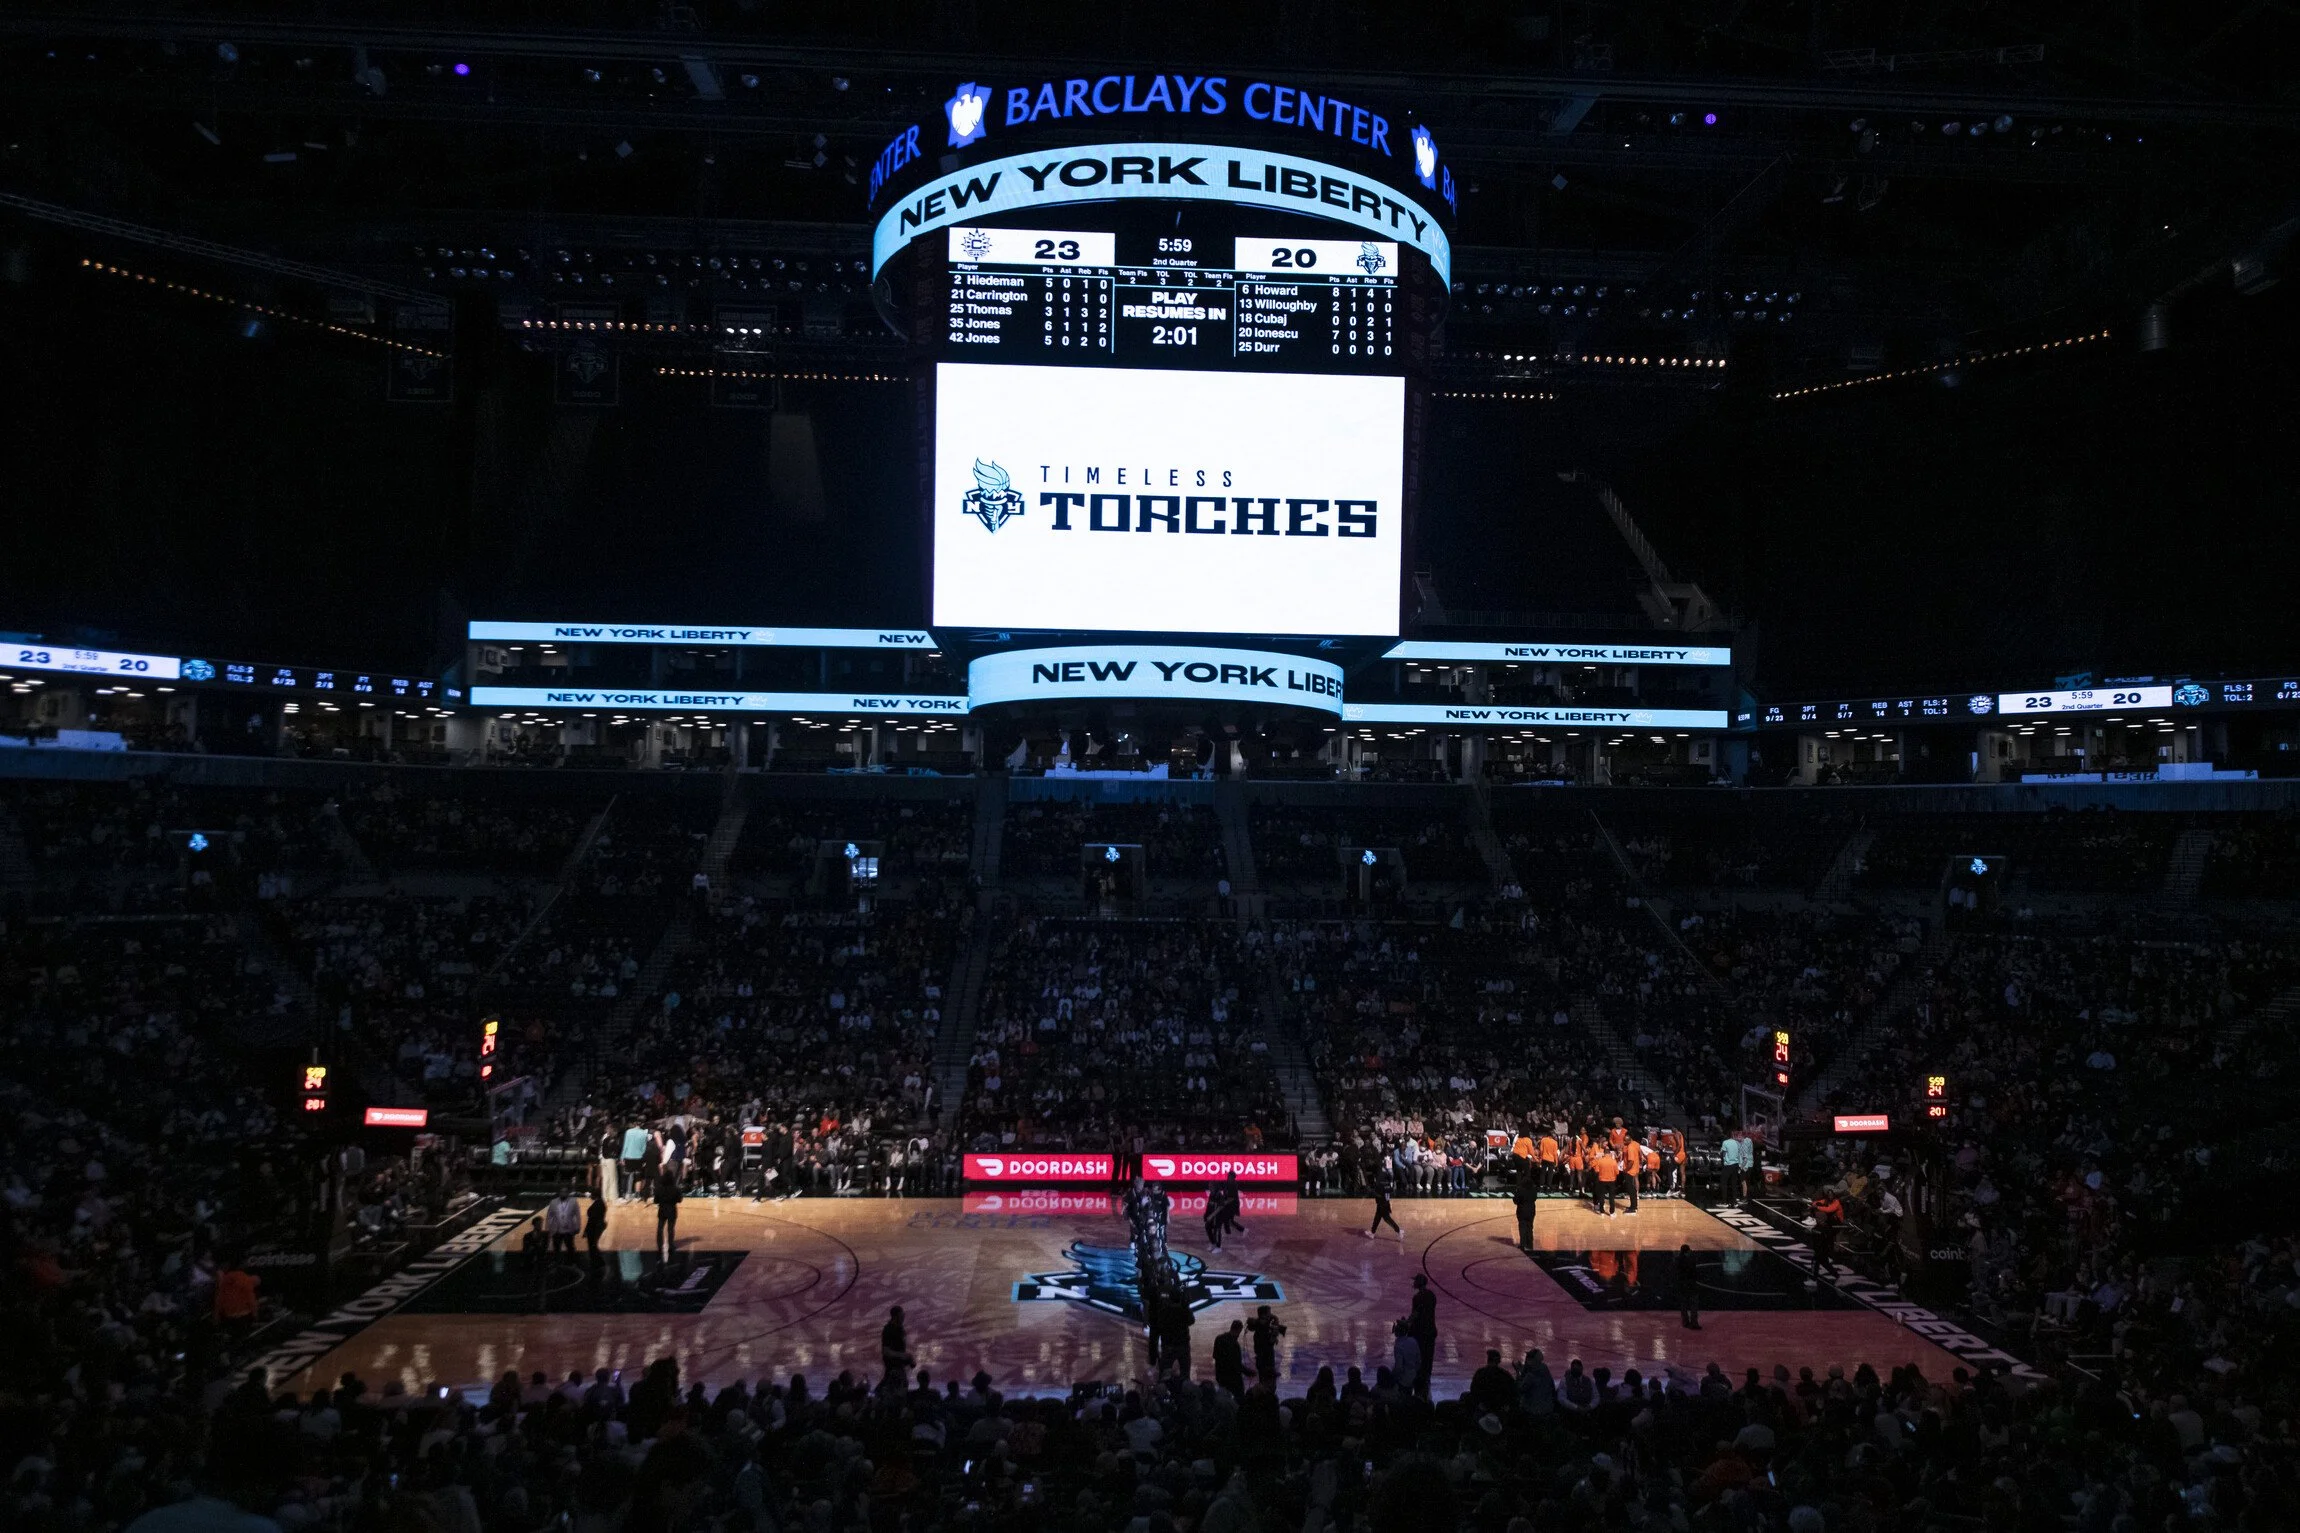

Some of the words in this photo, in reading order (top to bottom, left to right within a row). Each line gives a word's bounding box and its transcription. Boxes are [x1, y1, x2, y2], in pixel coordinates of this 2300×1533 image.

[1005, 75, 1227, 127] BARCLAYS
[1244, 81, 1392, 157] CENTER
[900, 171, 1002, 237] NEW
[1017, 156, 1210, 192] YORK
[1228, 160, 1427, 243] LIBERTY
[1035, 240, 1080, 260] 23
[1159, 238, 1192, 252] 5:59
[1272, 248, 1317, 268] 20
[954, 275, 961, 285] 2
[967, 275, 1024, 286] Hiedeman
[1046, 278, 1053, 287] 5
[1063, 279, 1070, 288] 0
[1083, 279, 1088, 288] 1
[1100, 280, 1107, 289] 0
[951, 290, 964, 299] 21
[966, 290, 1027, 302] Carrington
[1045, 292, 1053, 302] 0
[1063, 293, 1070, 302] 0
[1082, 294, 1088, 303] 1
[1100, 294, 1107, 304] 0
[1152, 291, 1197, 305] PLAY
[1242, 285, 1249, 294] 6
[1255, 285, 1298, 296] Howard
[1332, 288, 1339, 297] 8
[1351, 288, 1356, 297] 1
[1367, 289, 1374, 298] 4
[1386, 289, 1391, 298] 1
[950, 304, 964, 313] 25
[966, 304, 1012, 315] Thomas
[1045, 307, 1052, 316] 3
[1064, 308, 1069, 317] 1
[1081, 308, 1088, 317] 3
[1099, 309, 1107, 318] 2
[1123, 305, 1206, 319] RESUMES
[1208, 308, 1226, 320] IN
[1240, 300, 1252, 309] 13
[1255, 300, 1317, 313] Willoughby
[1333, 302, 1339, 311] 2
[1351, 302, 1356, 311] 1
[1367, 303, 1374, 312] 0
[1385, 303, 1392, 312] 0
[950, 318, 963, 328] 35
[966, 319, 1000, 329] Jones
[1045, 321, 1052, 330] 6
[1063, 322, 1069, 331] 1
[1082, 323, 1088, 332] 1
[1099, 323, 1106, 332] 2
[1240, 314, 1252, 322] 18
[1255, 314, 1287, 326] Cubaj
[1332, 316, 1339, 325] 0
[1350, 317, 1357, 326] 0
[1367, 317, 1374, 326] 2
[1386, 318, 1391, 327] 1
[949, 333, 963, 342] 42
[966, 333, 1000, 343] Jones
[1045, 336, 1052, 345] 5
[1062, 336, 1069, 346] 0
[1081, 337, 1088, 346] 2
[1099, 338, 1106, 347] 0
[1152, 326, 1197, 345] 2:01
[1239, 328, 1252, 337] 20
[1255, 328, 1298, 338] Ionescu
[1332, 330, 1339, 340] 7
[1350, 331, 1356, 340] 0
[1367, 331, 1374, 341] 3
[1386, 332, 1391, 341] 1
[1239, 342, 1252, 351] 25
[1255, 342, 1280, 352] Durr
[1332, 345, 1339, 354] 0
[1350, 345, 1356, 354] 0
[1367, 346, 1374, 355] 0
[1385, 346, 1392, 356] 0
[1040, 465, 1233, 488] TIMELESS
[1040, 492, 1377, 538] TORCHES
[555, 627, 604, 638] NEW
[609, 628, 665, 639] YORK
[669, 629, 751, 641] LIBERTY
[878, 634, 926, 644] NEW
[19, 650, 50, 663] 23
[120, 659, 148, 671] 20
[1504, 648, 1550, 658] NEW
[1554, 649, 1608, 659] YORK
[1612, 650, 1689, 660] LIBERTY
[1032, 661, 1138, 683] NEW
[1151, 661, 1279, 687] YORK
[546, 693, 596, 704] NEW
[601, 694, 657, 705] YORK
[662, 695, 745, 706] LIBERTY
[853, 698, 901, 709] NEW
[905, 699, 961, 710] YORK
[2025, 697, 2052, 708] 23
[2072, 691, 2093, 700] 5:59
[2113, 693, 2142, 704] 20
[1445, 710, 1492, 720] NEW
[1496, 710, 1549, 721] YORK
[1553, 712, 1631, 722] LIBERTY
[1928, 1085, 1942, 1096] 24
[1009, 1161, 1108, 1174] DOORDASH
[1181, 1161, 1278, 1175] DOORDASH
[1705, 1208, 1796, 1241] NEW
[406, 1207, 537, 1269] LIBERTY
